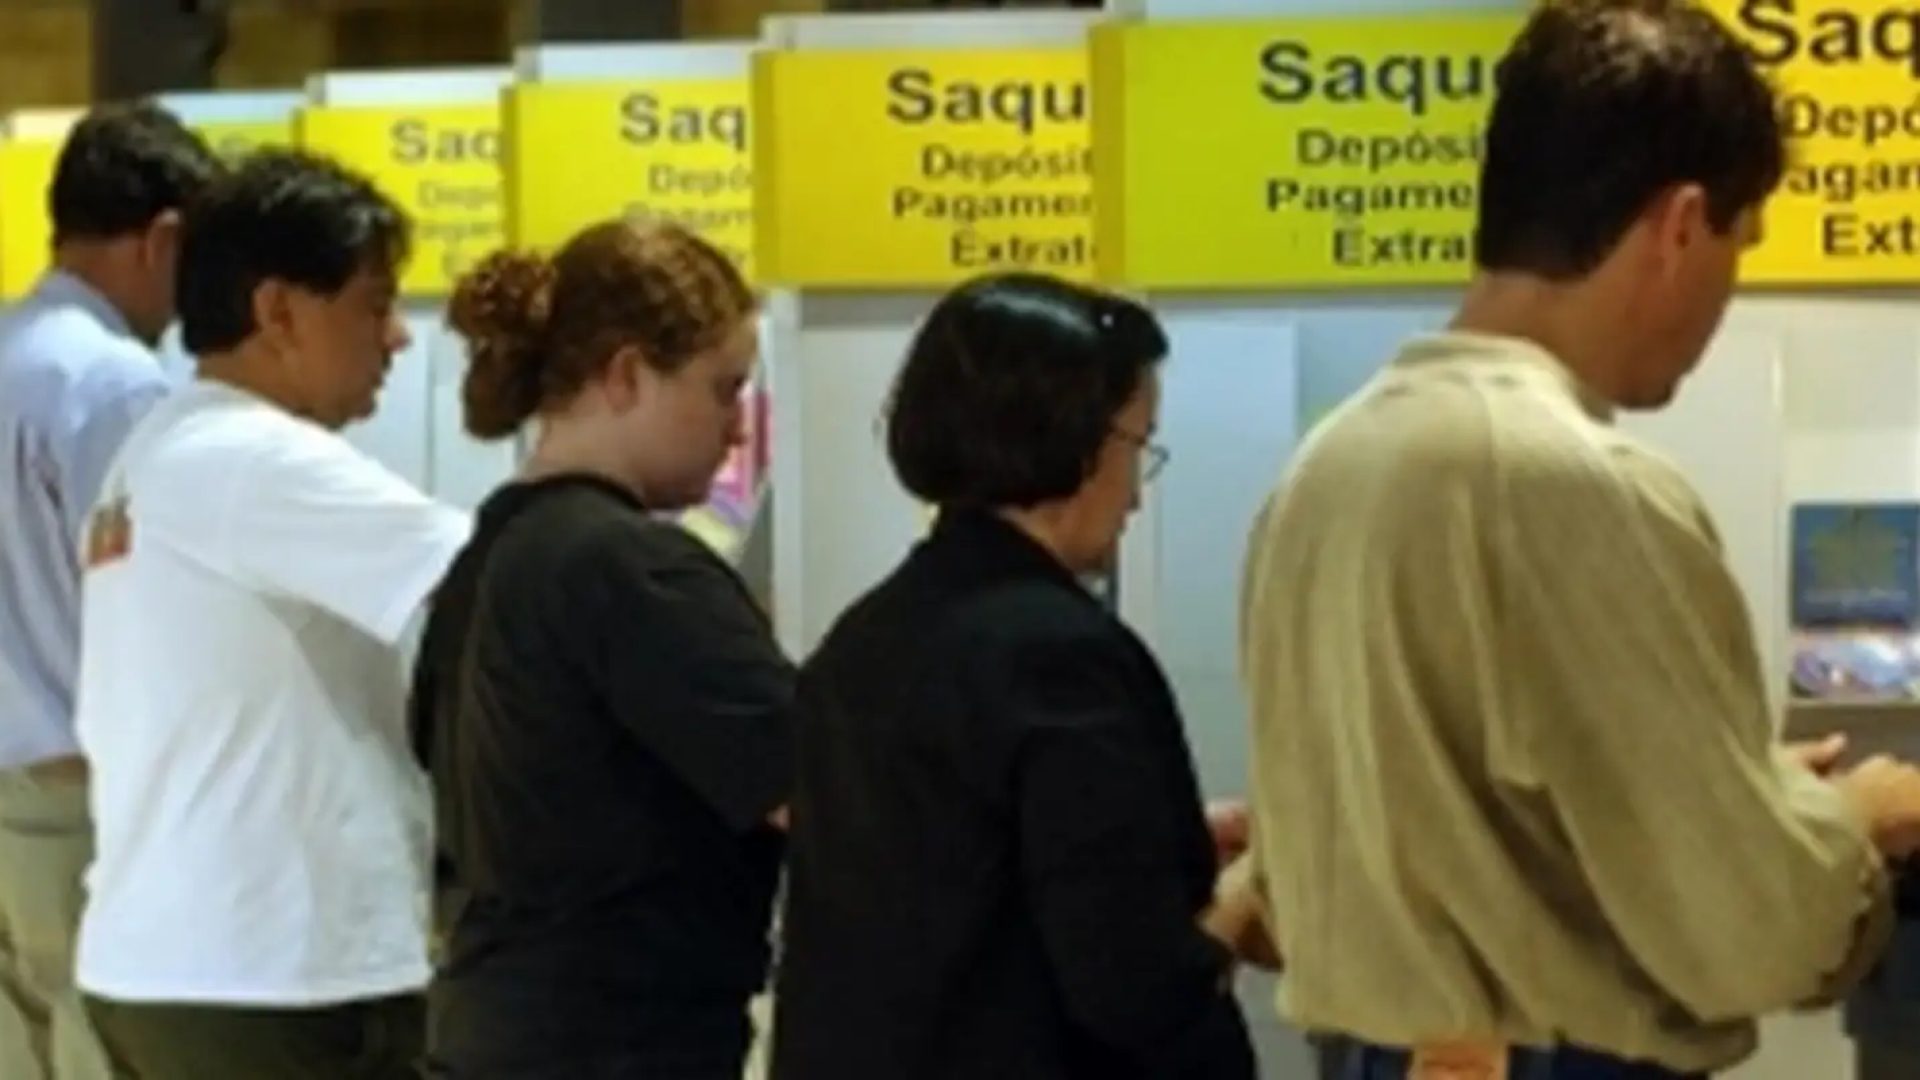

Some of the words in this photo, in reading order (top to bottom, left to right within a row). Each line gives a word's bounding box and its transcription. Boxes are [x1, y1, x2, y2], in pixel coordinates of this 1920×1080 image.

[1738, 0, 1920, 80] Saq
[888, 69, 1085, 134] Saqu
[1260, 41, 1499, 116] Saqu
[620, 92, 746, 152] Saq
[952, 231, 1100, 266] Extrat
